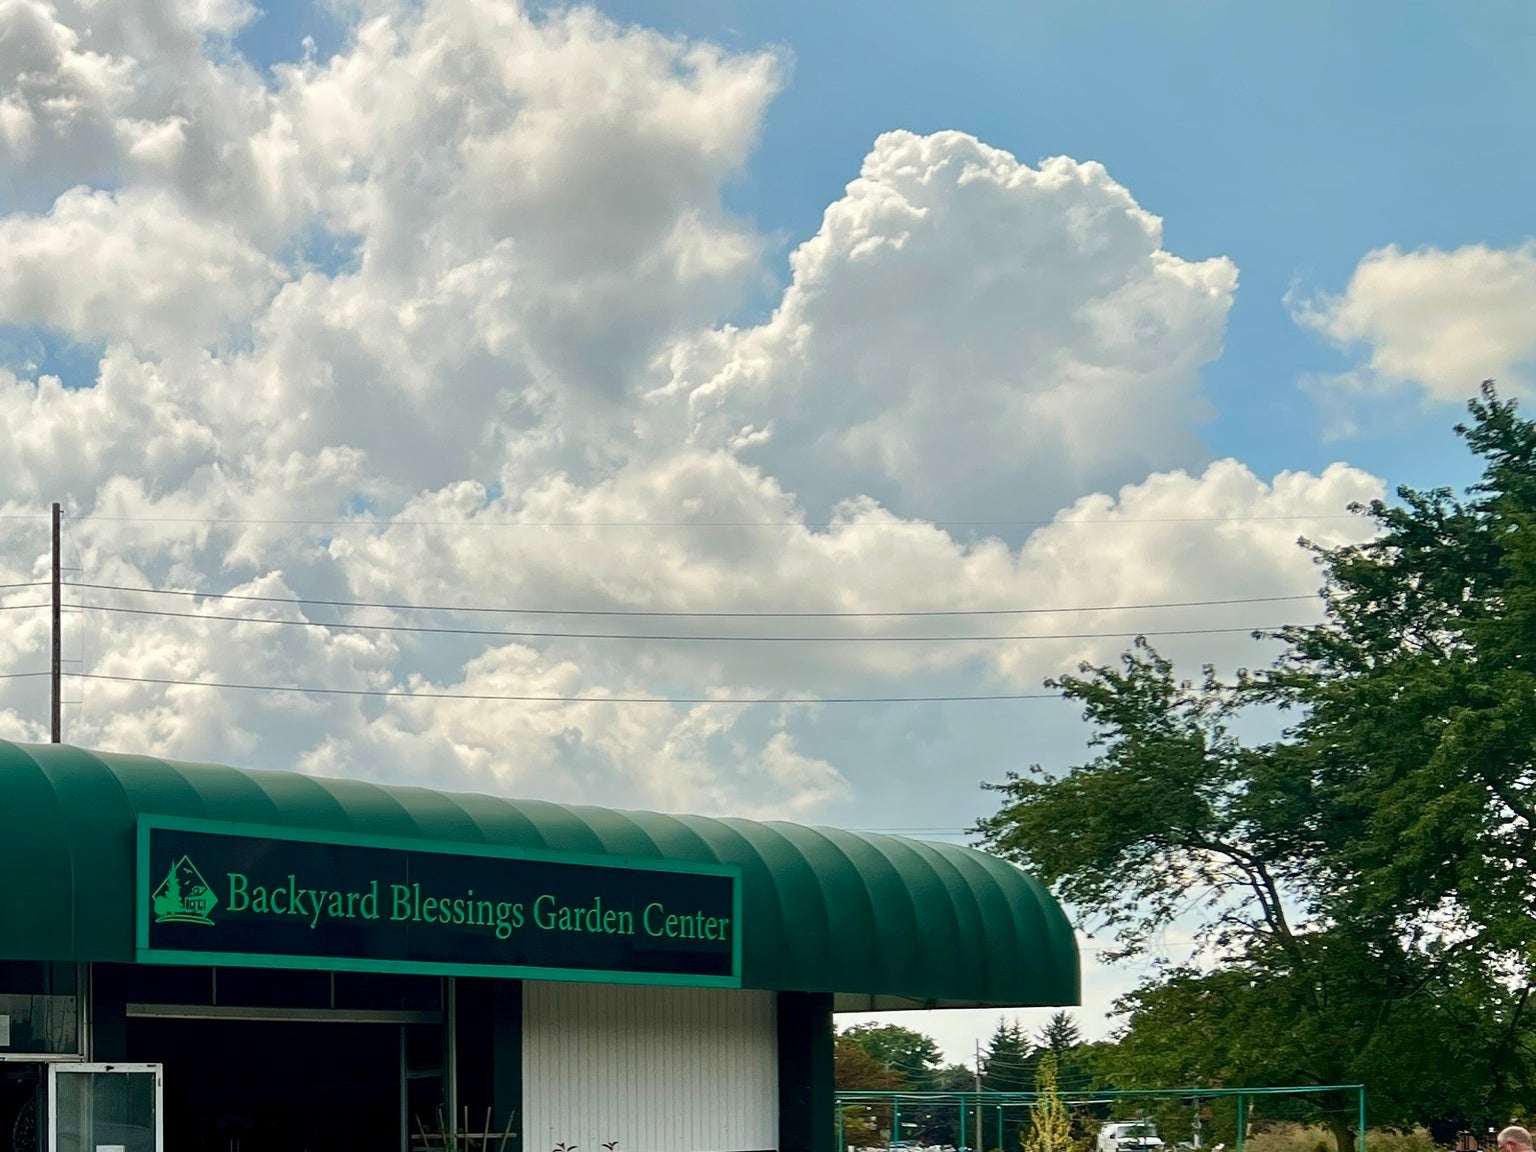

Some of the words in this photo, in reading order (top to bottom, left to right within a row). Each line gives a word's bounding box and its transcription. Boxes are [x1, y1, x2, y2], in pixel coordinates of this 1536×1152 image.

[226, 873, 380, 929] Backyard
[390, 883, 524, 939] Blessings
[533, 895, 635, 934] Garden
[643, 902, 729, 940] Center
